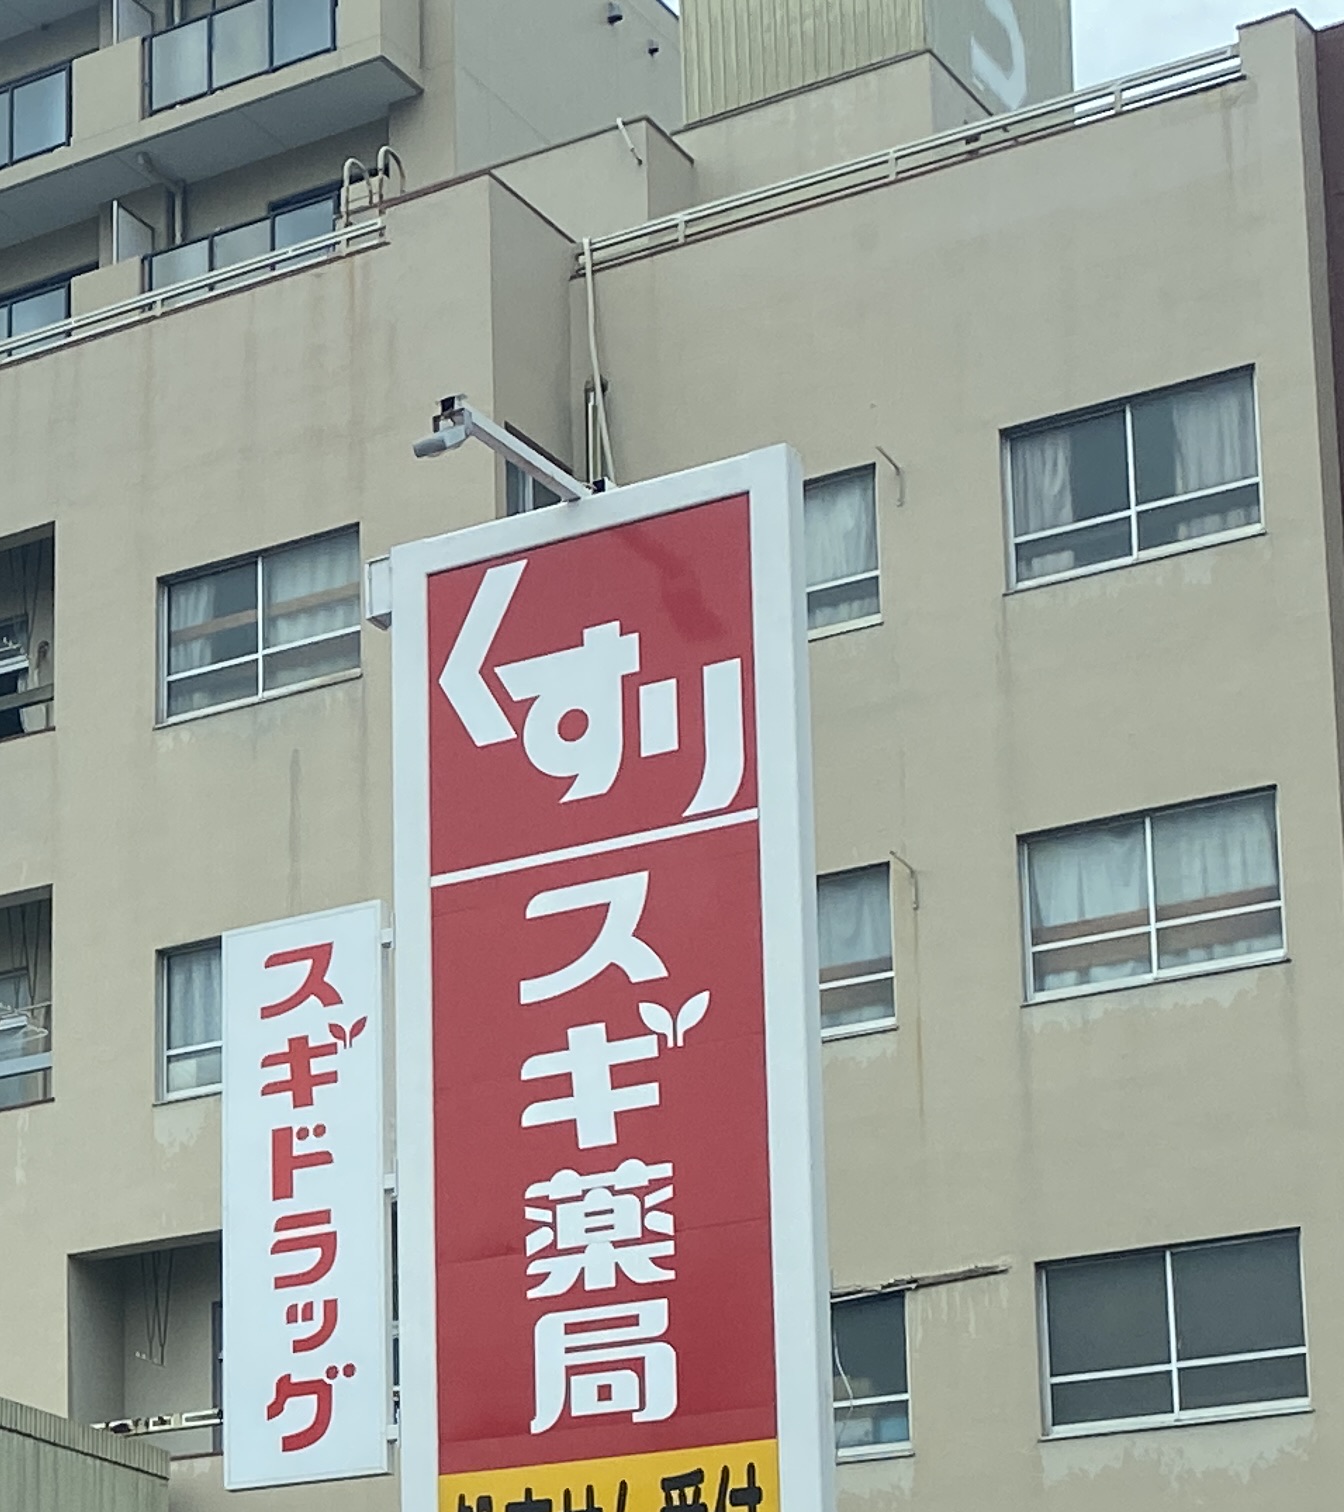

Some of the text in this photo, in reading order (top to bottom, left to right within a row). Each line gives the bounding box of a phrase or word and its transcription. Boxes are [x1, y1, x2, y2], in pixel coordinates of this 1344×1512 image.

[439, 559, 746, 817] くすり
[260, 942, 368, 1452] スギドラッグ
[520, 871, 711, 1435] スギ薬局
